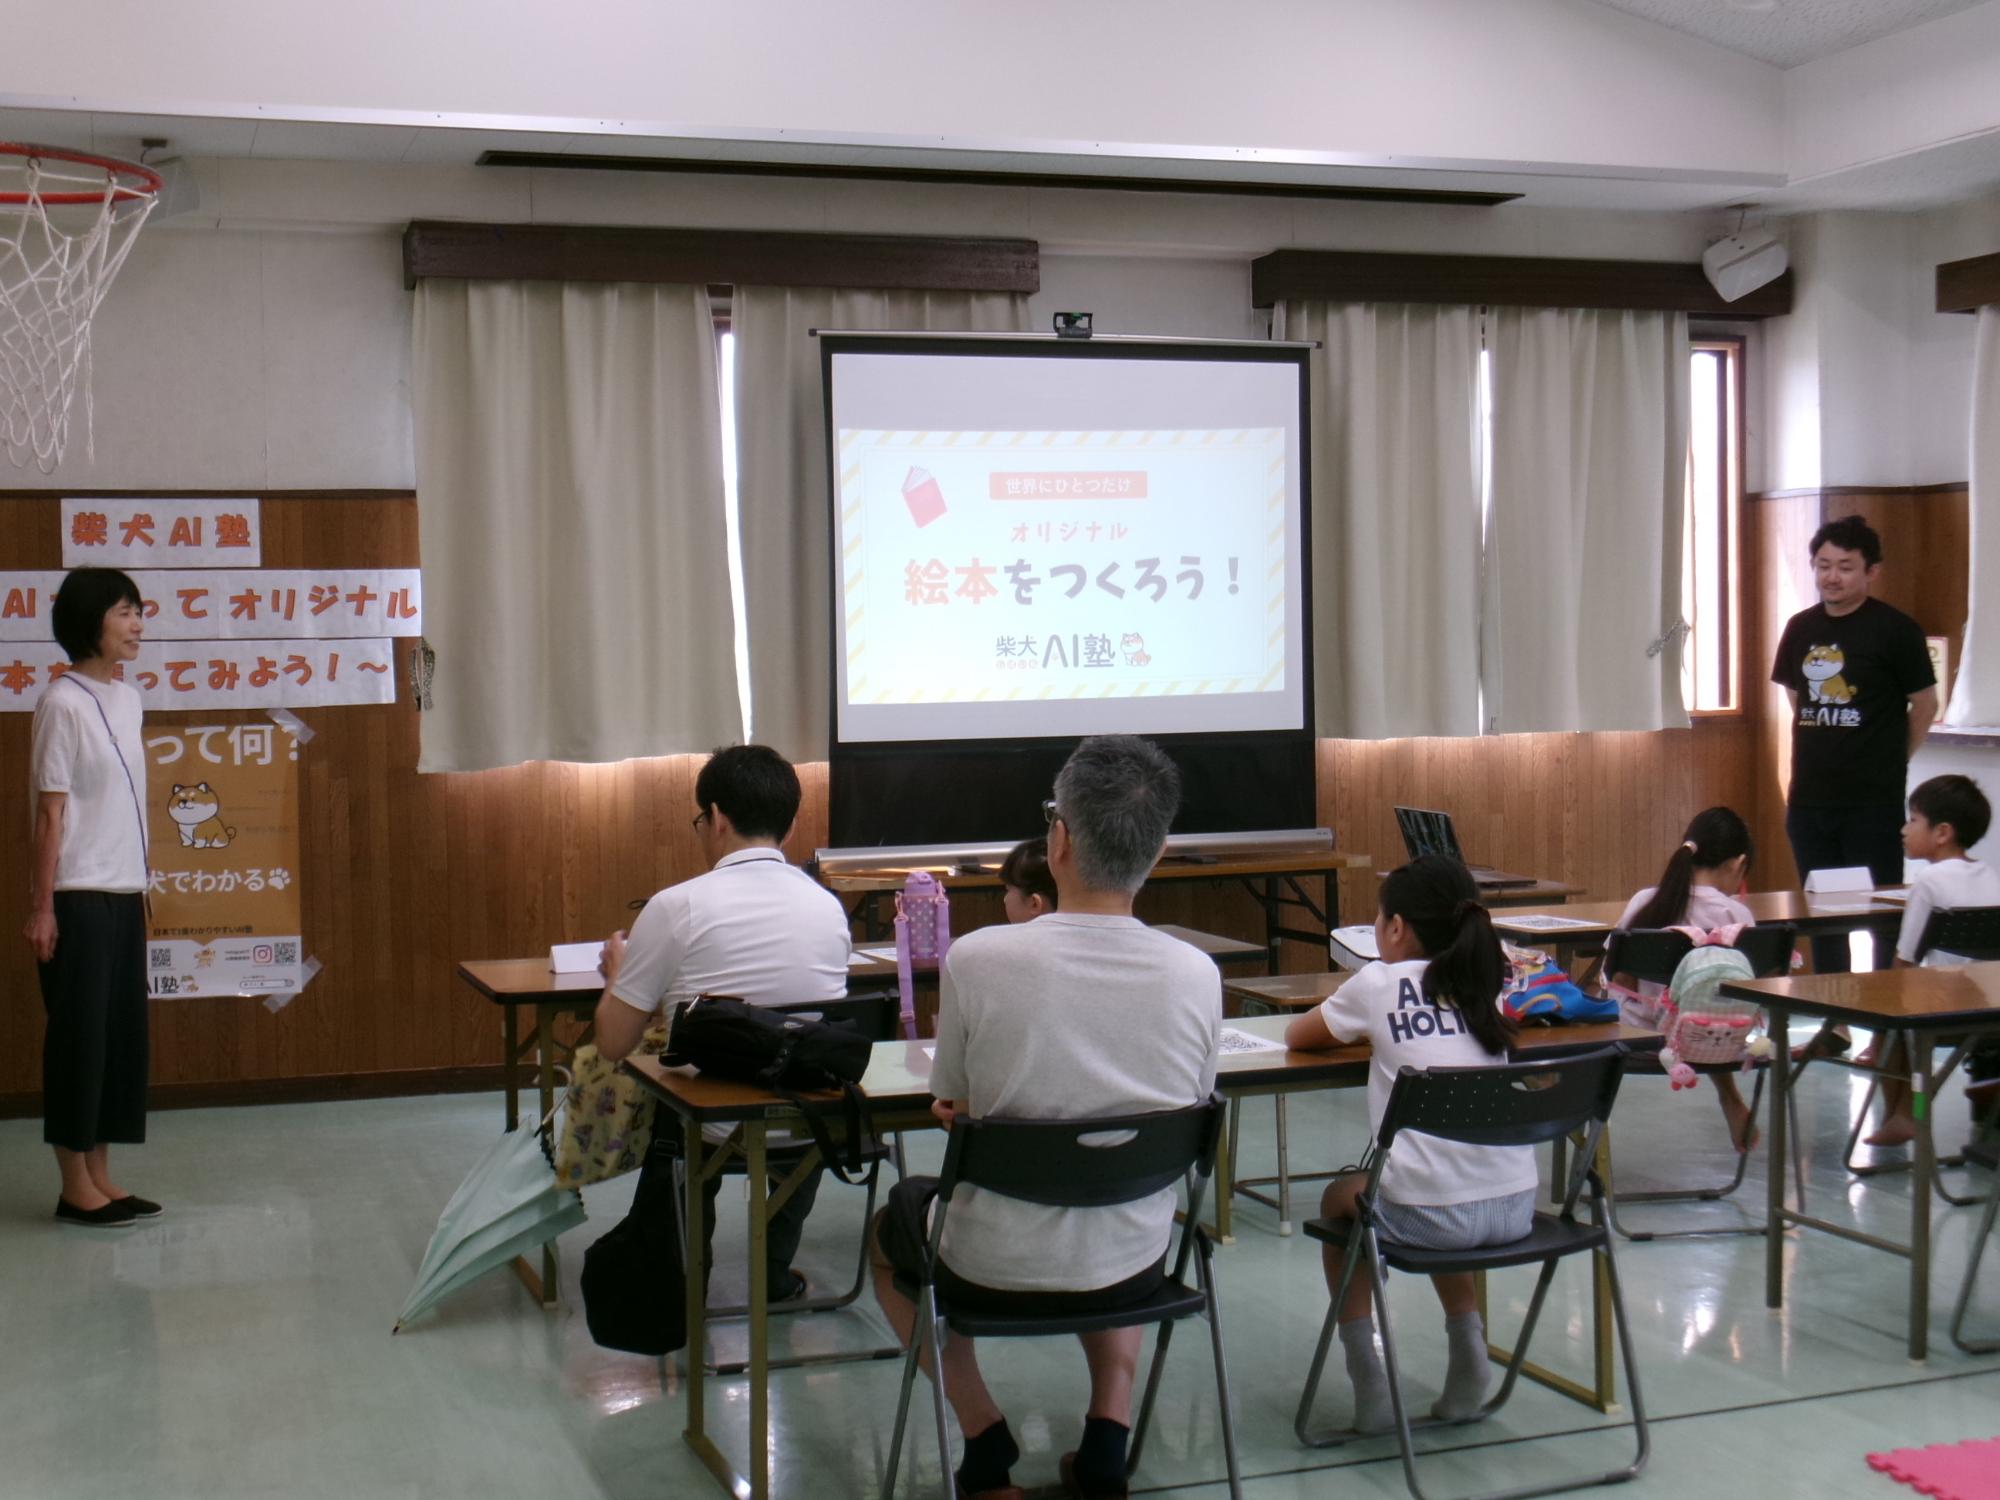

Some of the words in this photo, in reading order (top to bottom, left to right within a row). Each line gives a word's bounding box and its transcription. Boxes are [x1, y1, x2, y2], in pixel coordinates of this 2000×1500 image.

[1006, 477, 1131, 496] 世界にひとつだけ
[72, 511, 250, 547] 柴犬AI塾
[1010, 521, 1129, 544] オリジナル
[904, 555, 1240, 605] 絵本をつくろう！
[1387, 1009, 1472, 1043] HOLI
